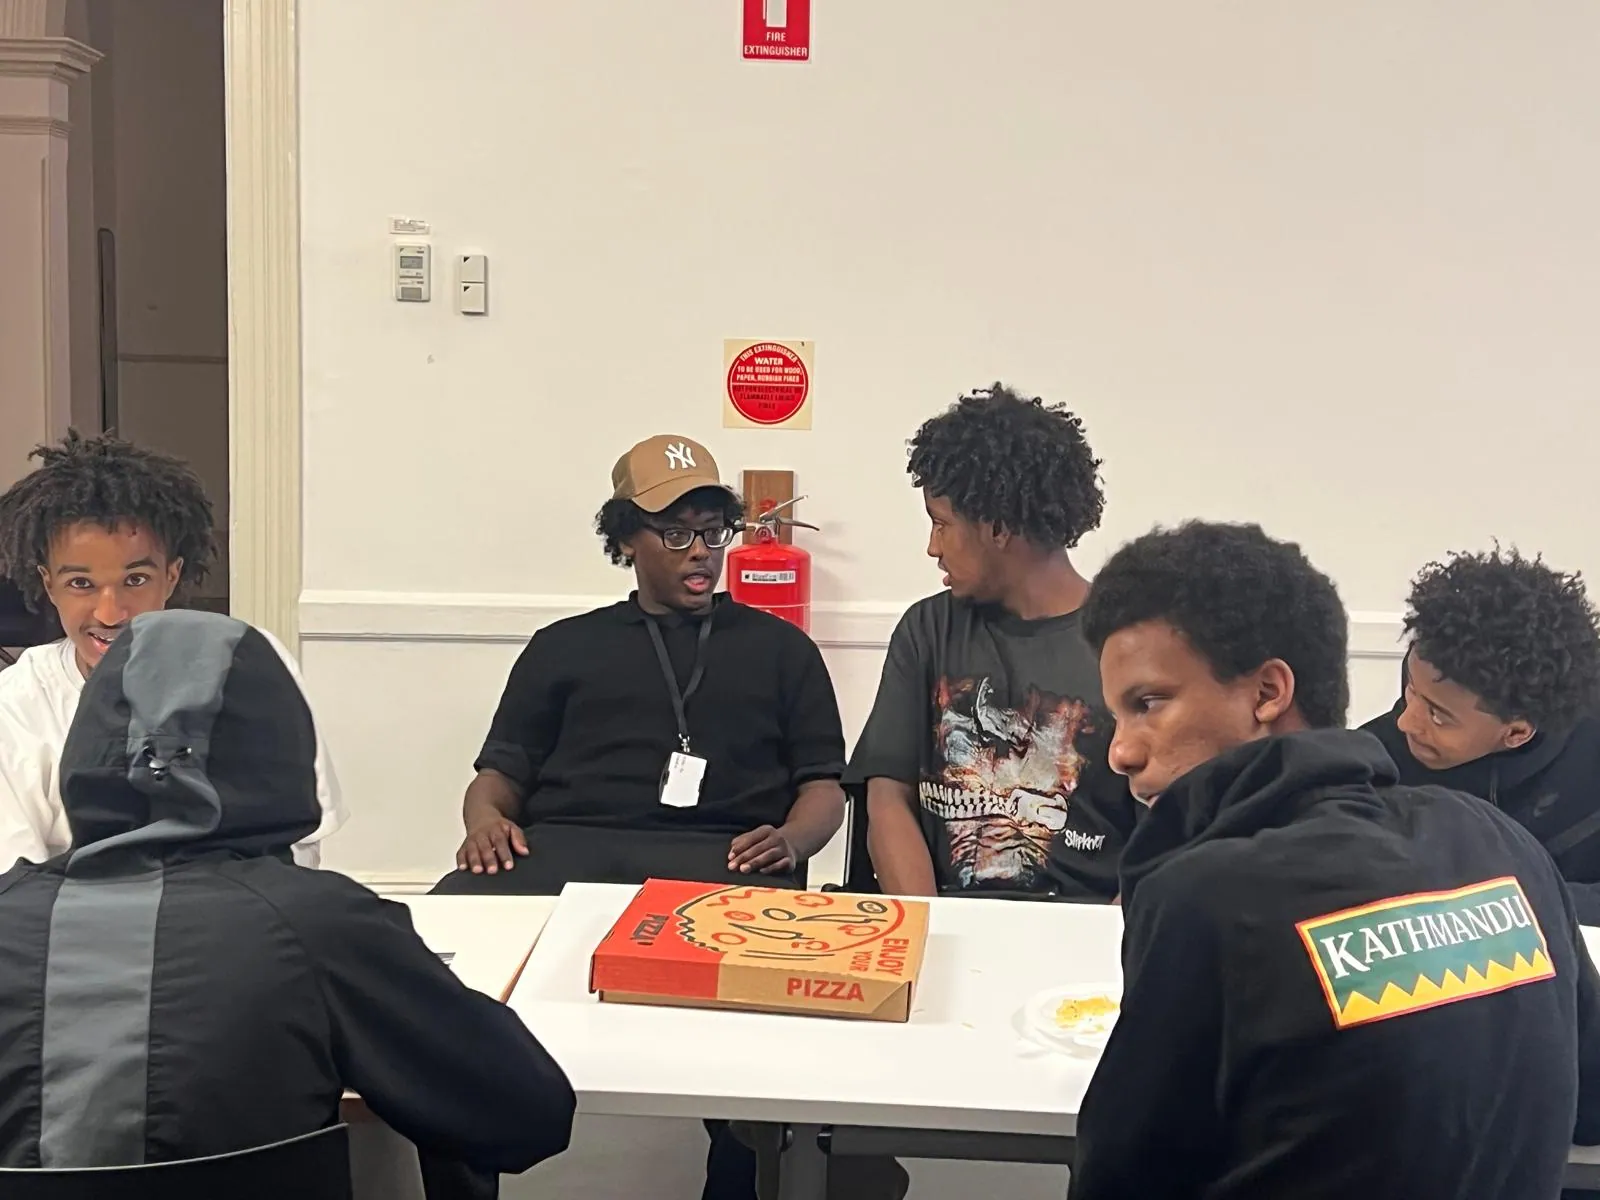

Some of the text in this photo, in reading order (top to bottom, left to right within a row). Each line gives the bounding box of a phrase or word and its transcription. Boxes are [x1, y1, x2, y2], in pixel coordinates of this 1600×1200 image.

[766, 32, 786, 41] FIRE
[744, 45, 808, 57] EXTINGUISHER
[740, 349, 754, 361] THIS
[754, 357, 783, 365] WATER
[664, 442, 697, 469] NY
[1320, 895, 1532, 979] KATHMANDU
[849, 950, 874, 972] YOUR
[875, 937, 910, 977] ENJOY
[787, 976, 865, 1003] PIZZA
